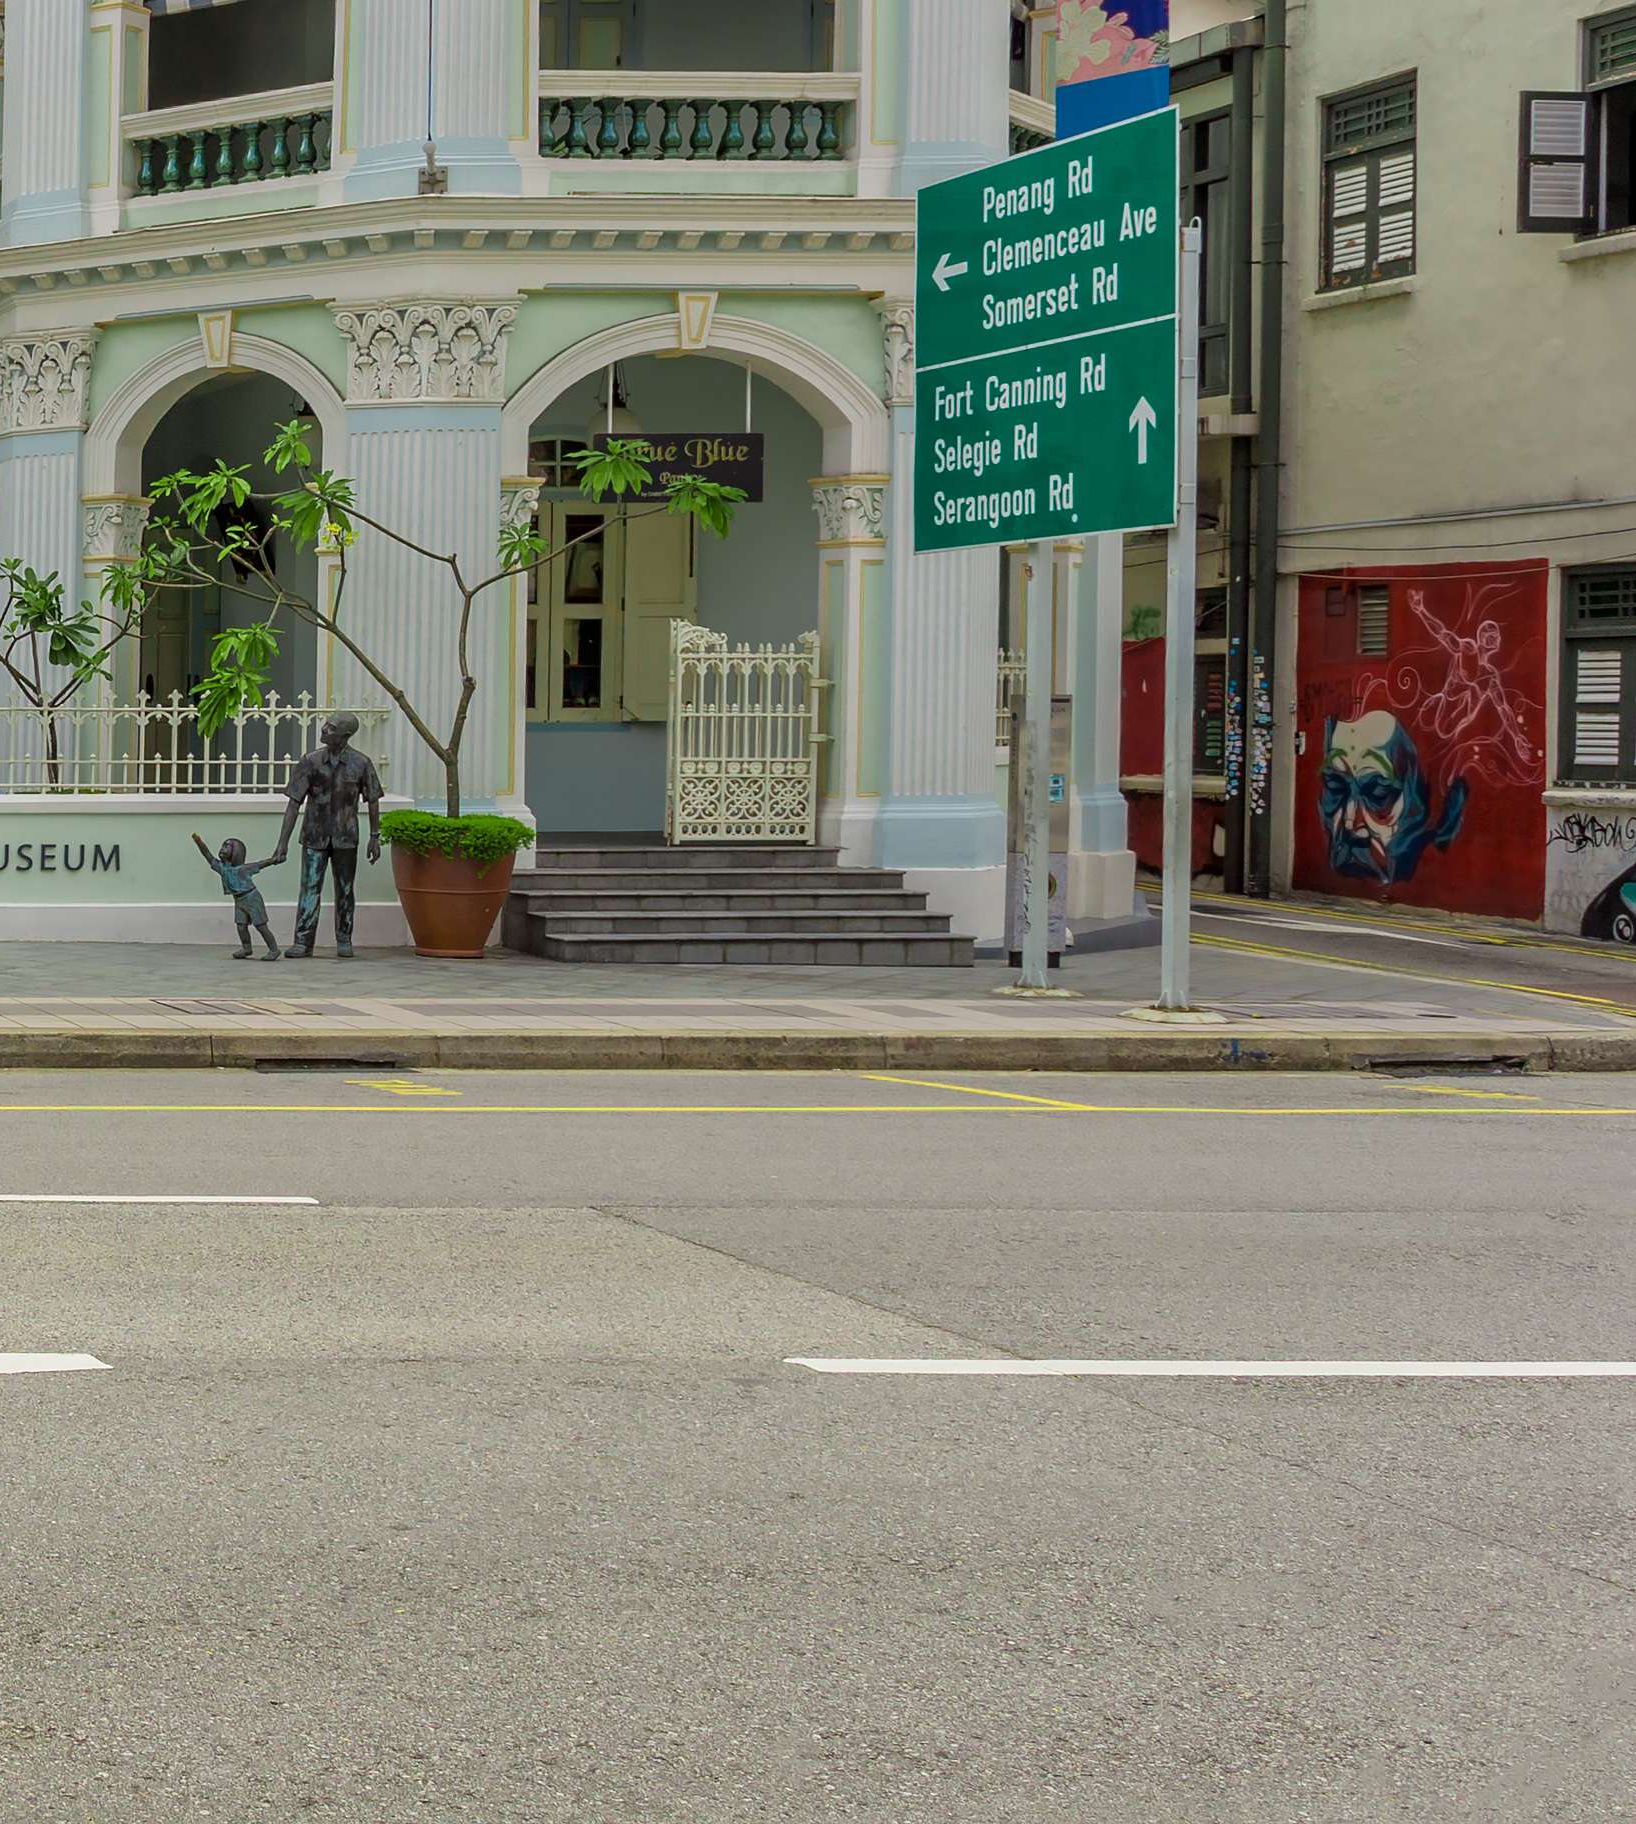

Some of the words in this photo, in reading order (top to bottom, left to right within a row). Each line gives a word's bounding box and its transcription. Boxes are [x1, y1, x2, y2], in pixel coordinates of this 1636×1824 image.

[983, 177, 1054, 223] Penang
[1068, 156, 1093, 199] Rd
[982, 219, 1105, 276] Clemenceau
[1119, 202, 1157, 242] Ave
[982, 273, 1078, 329] Somerset
[1092, 263, 1118, 306] Rd
[934, 380, 973, 422] Fort
[985, 367, 1067, 412] Canning
[1080, 354, 1106, 395] Rd
[621, 438, 678, 464] rue
[684, 438, 750, 468] Blue
[934, 432, 1001, 478] Selegie
[1013, 422, 1038, 462] Rd
[934, 489, 1036, 529] Serangoon
[1049, 473, 1074, 512] Rd
